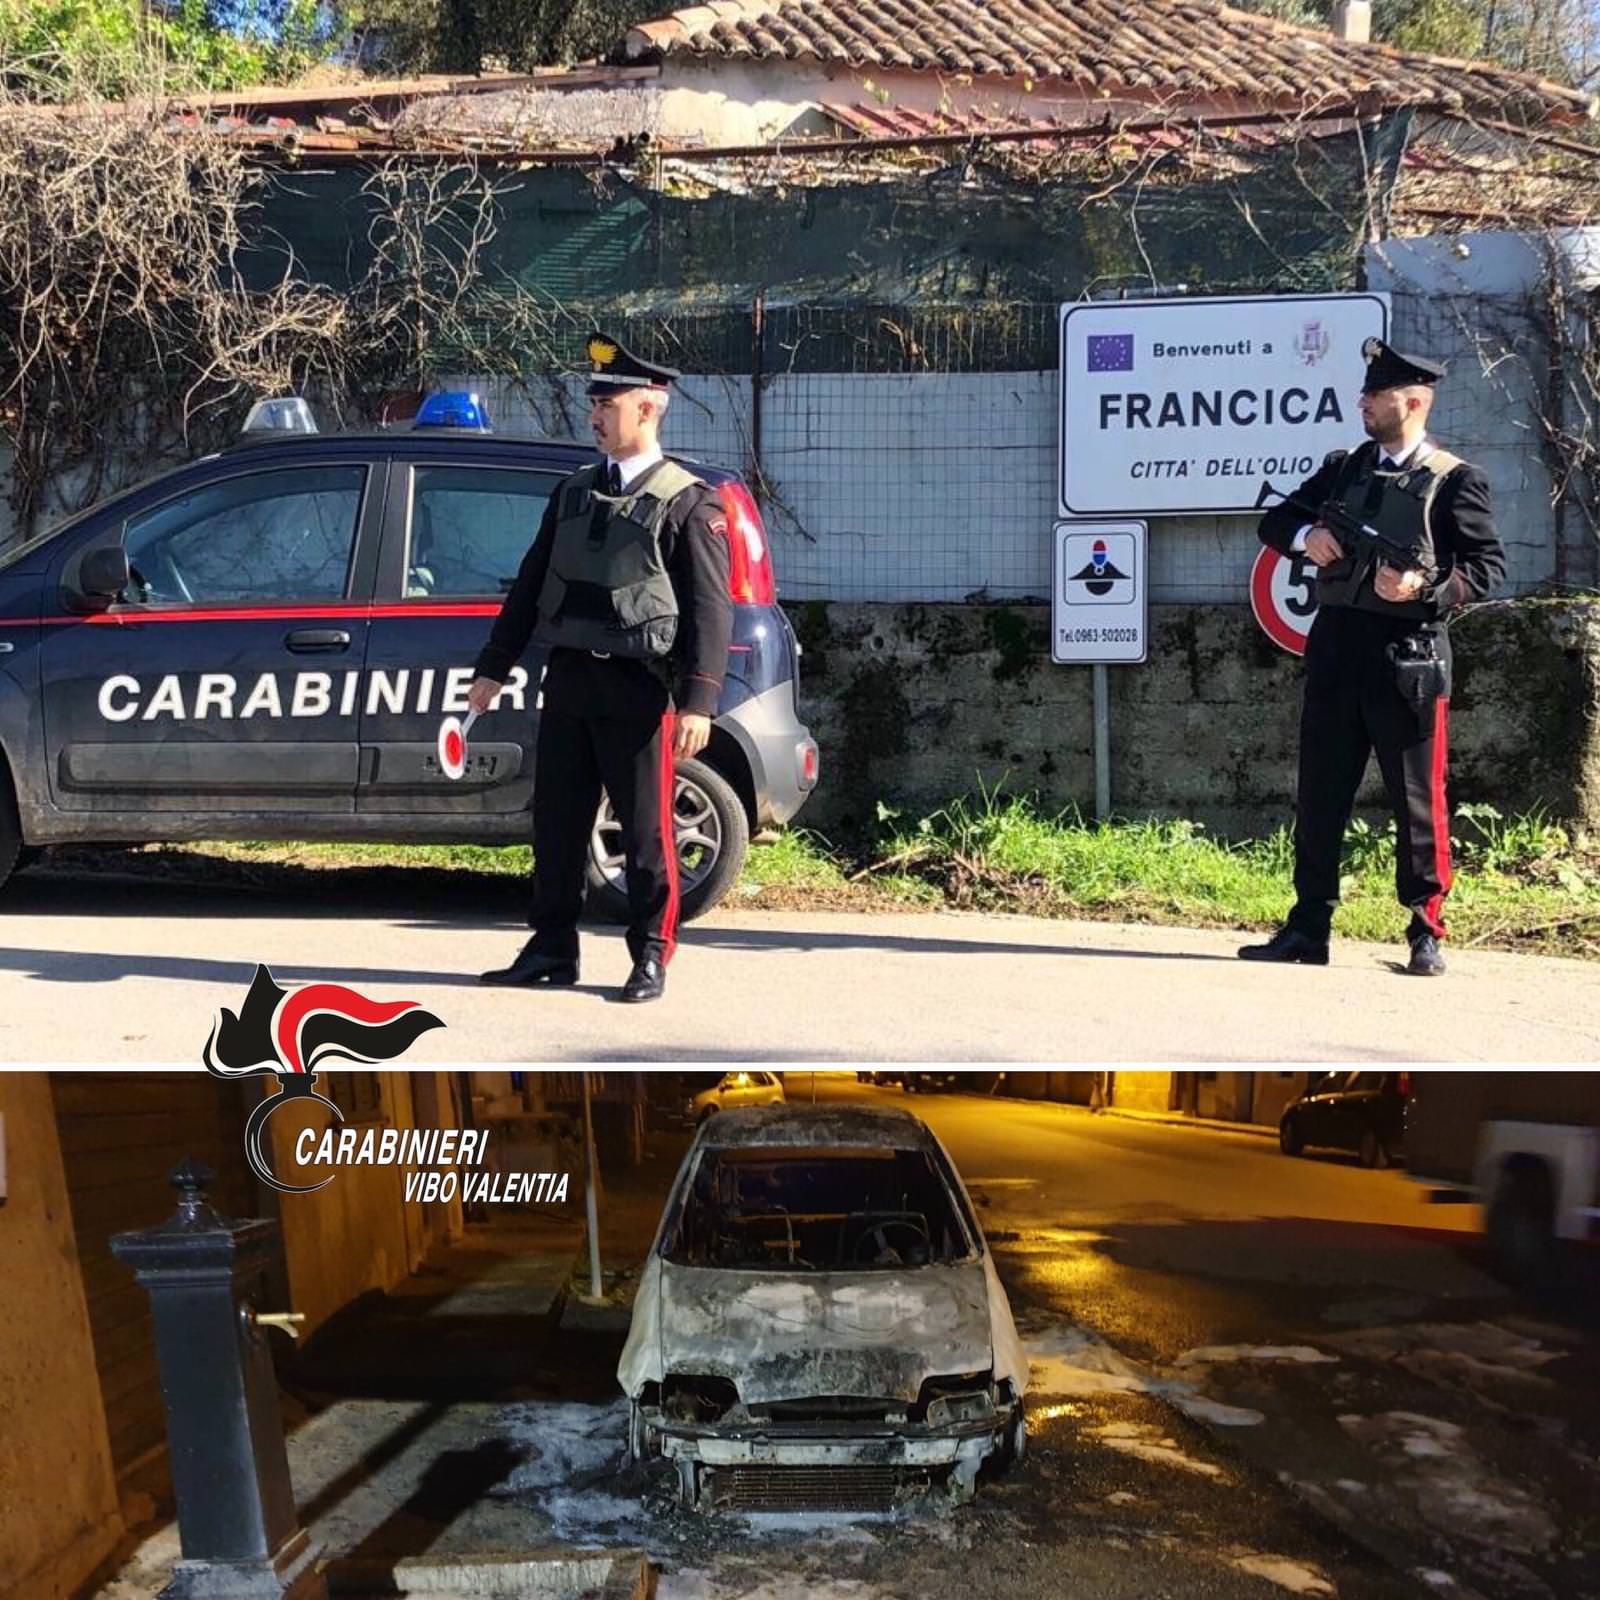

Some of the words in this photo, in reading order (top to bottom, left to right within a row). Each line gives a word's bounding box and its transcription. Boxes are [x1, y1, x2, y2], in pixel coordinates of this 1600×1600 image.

[1152, 340, 1251, 358] Benvenuti
[1262, 342, 1273, 354] a
[1099, 387, 1344, 429] FRANCICA
[1130, 459, 1196, 478] CITTA'
[1205, 456, 1313, 477] DELL'OLIO
